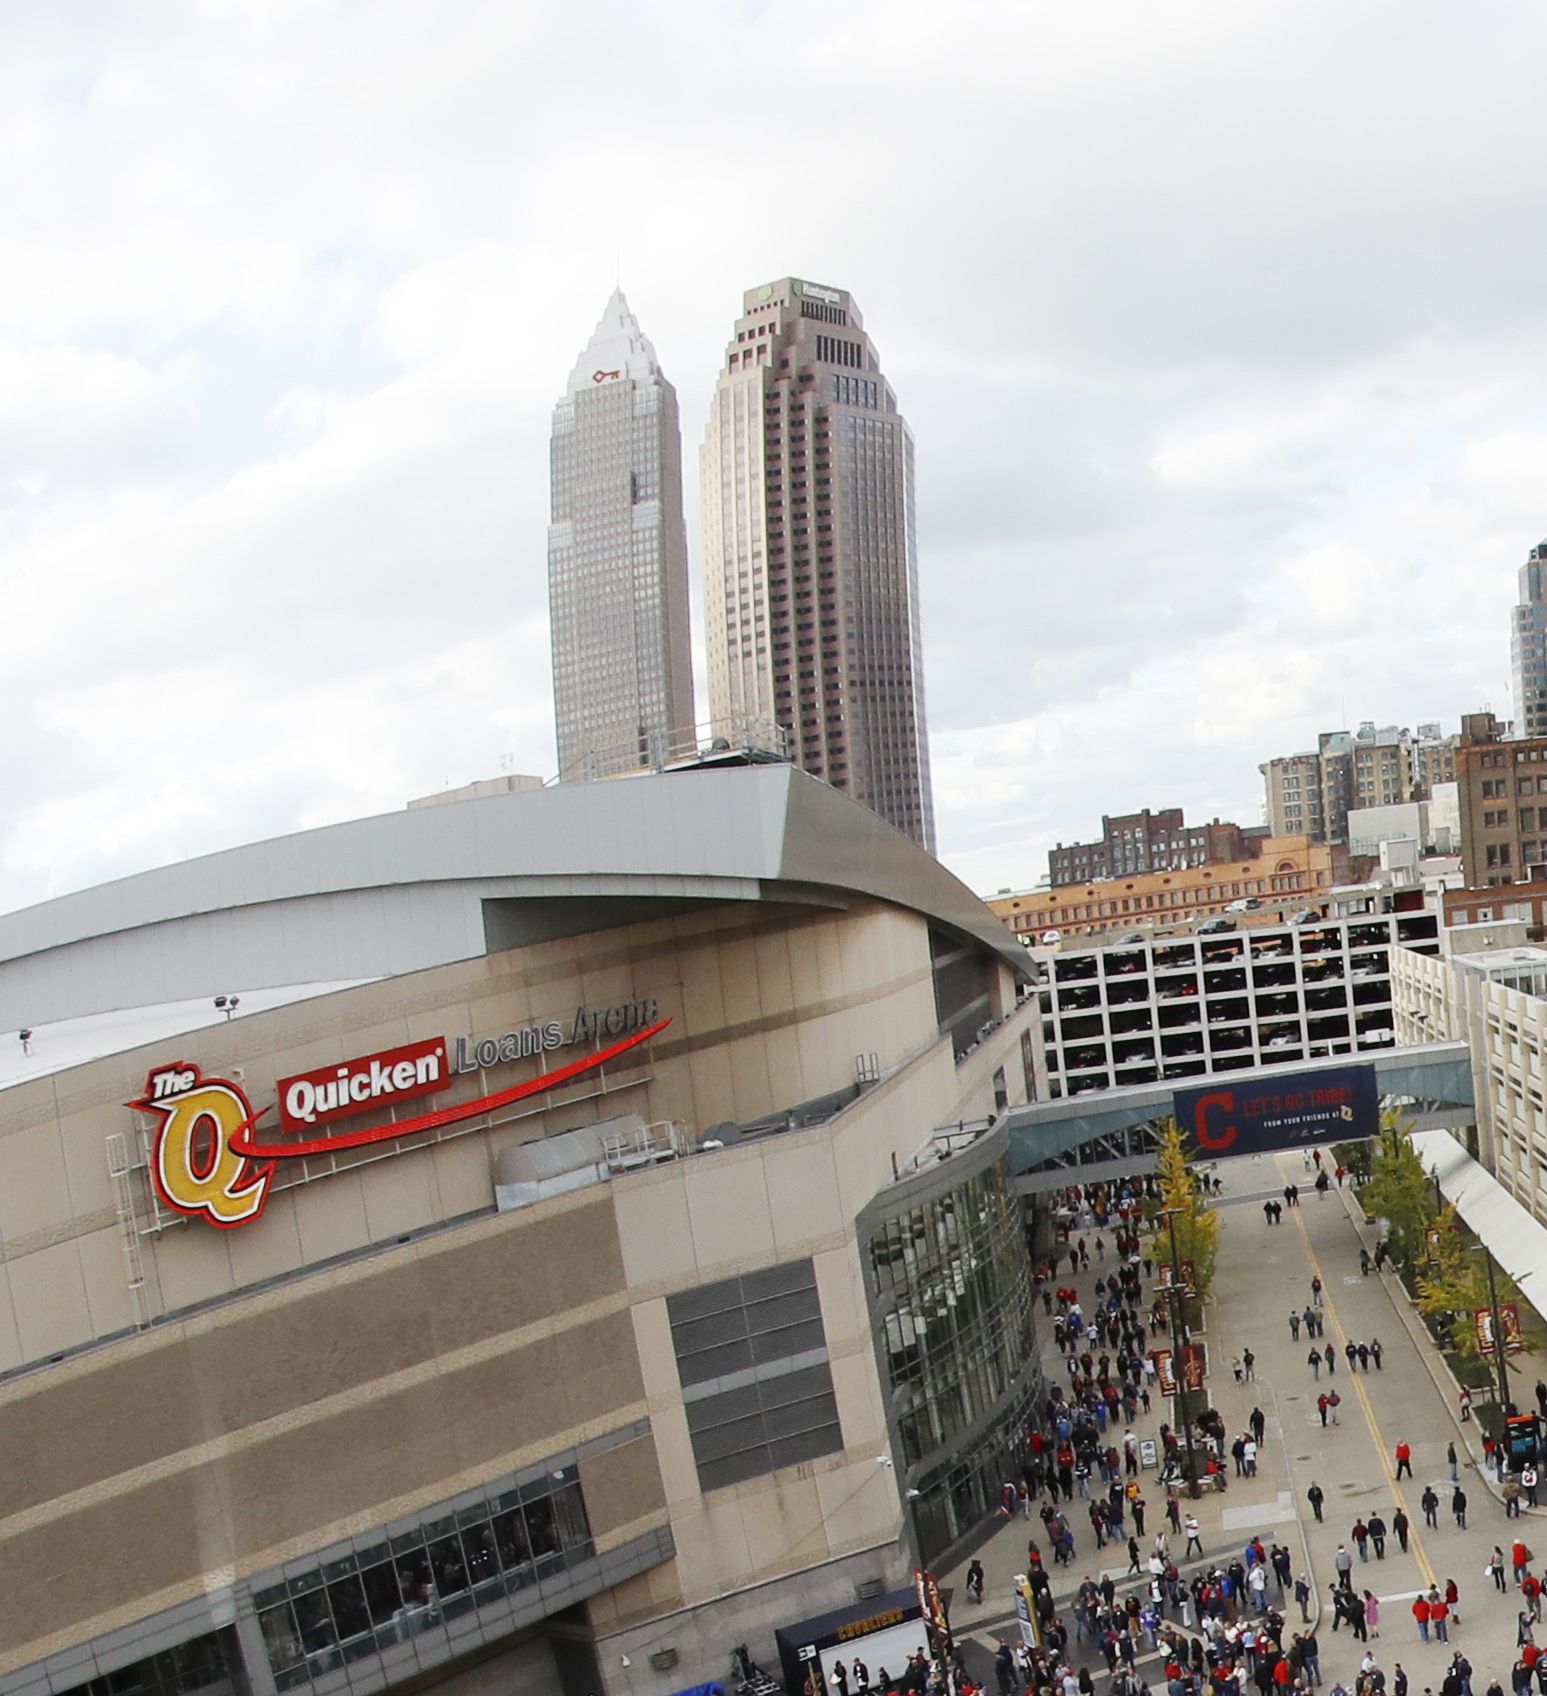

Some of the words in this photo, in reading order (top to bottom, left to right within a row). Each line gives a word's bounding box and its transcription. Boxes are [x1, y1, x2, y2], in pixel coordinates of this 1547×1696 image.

[286, 1060, 440, 1122] Quicken
[455, 1019, 564, 1073] Loans
[573, 998, 658, 1046] Arena
[153, 1068, 195, 1099] The
[1243, 1098, 1281, 1116] LET'S
[1285, 1093, 1304, 1110] GO
[1195, 1091, 1237, 1149] C
[1263, 1118, 1281, 1128] FROM
[1284, 1116, 1300, 1126] YOUR
[1302, 1112, 1330, 1123] FRIENDS
[151, 1085, 266, 1222] Q
